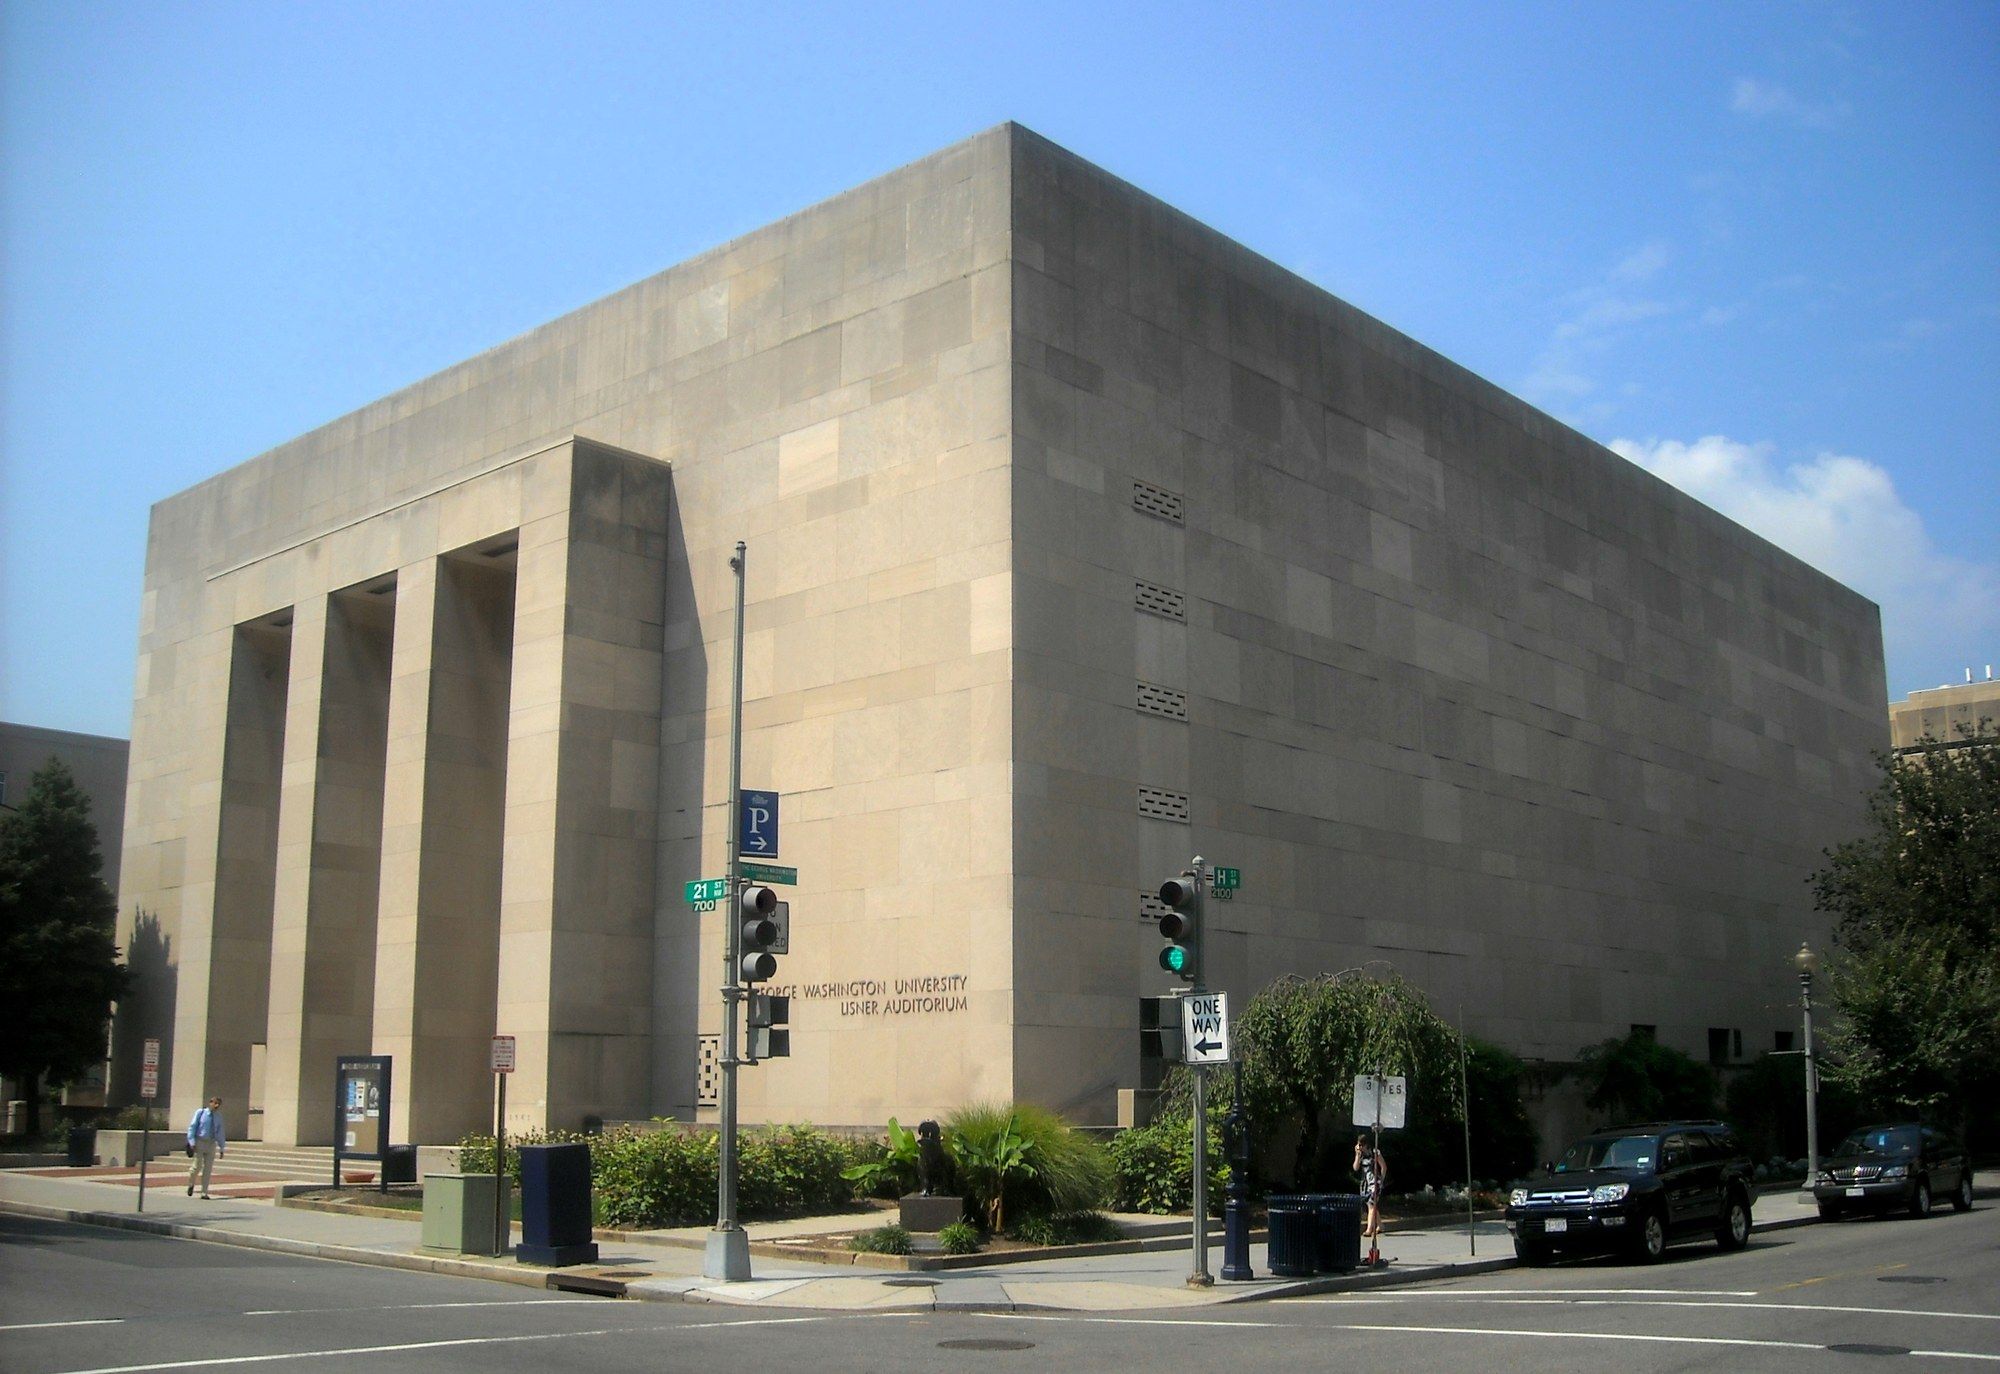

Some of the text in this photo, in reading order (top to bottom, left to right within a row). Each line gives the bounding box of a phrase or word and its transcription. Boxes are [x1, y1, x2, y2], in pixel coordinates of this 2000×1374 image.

[749, 807, 769, 834] P
[1217, 869, 1226, 885] H
[693, 881, 722, 899] 21 ST
[693, 900, 715, 911] 700
[757, 976, 967, 1000] EORGE WASHINGTON UNIVERSITY
[884, 996, 968, 1014] AUDITORIUM
[1192, 999, 1221, 1015] ONE
[1192, 1017, 1222, 1034] WAY
